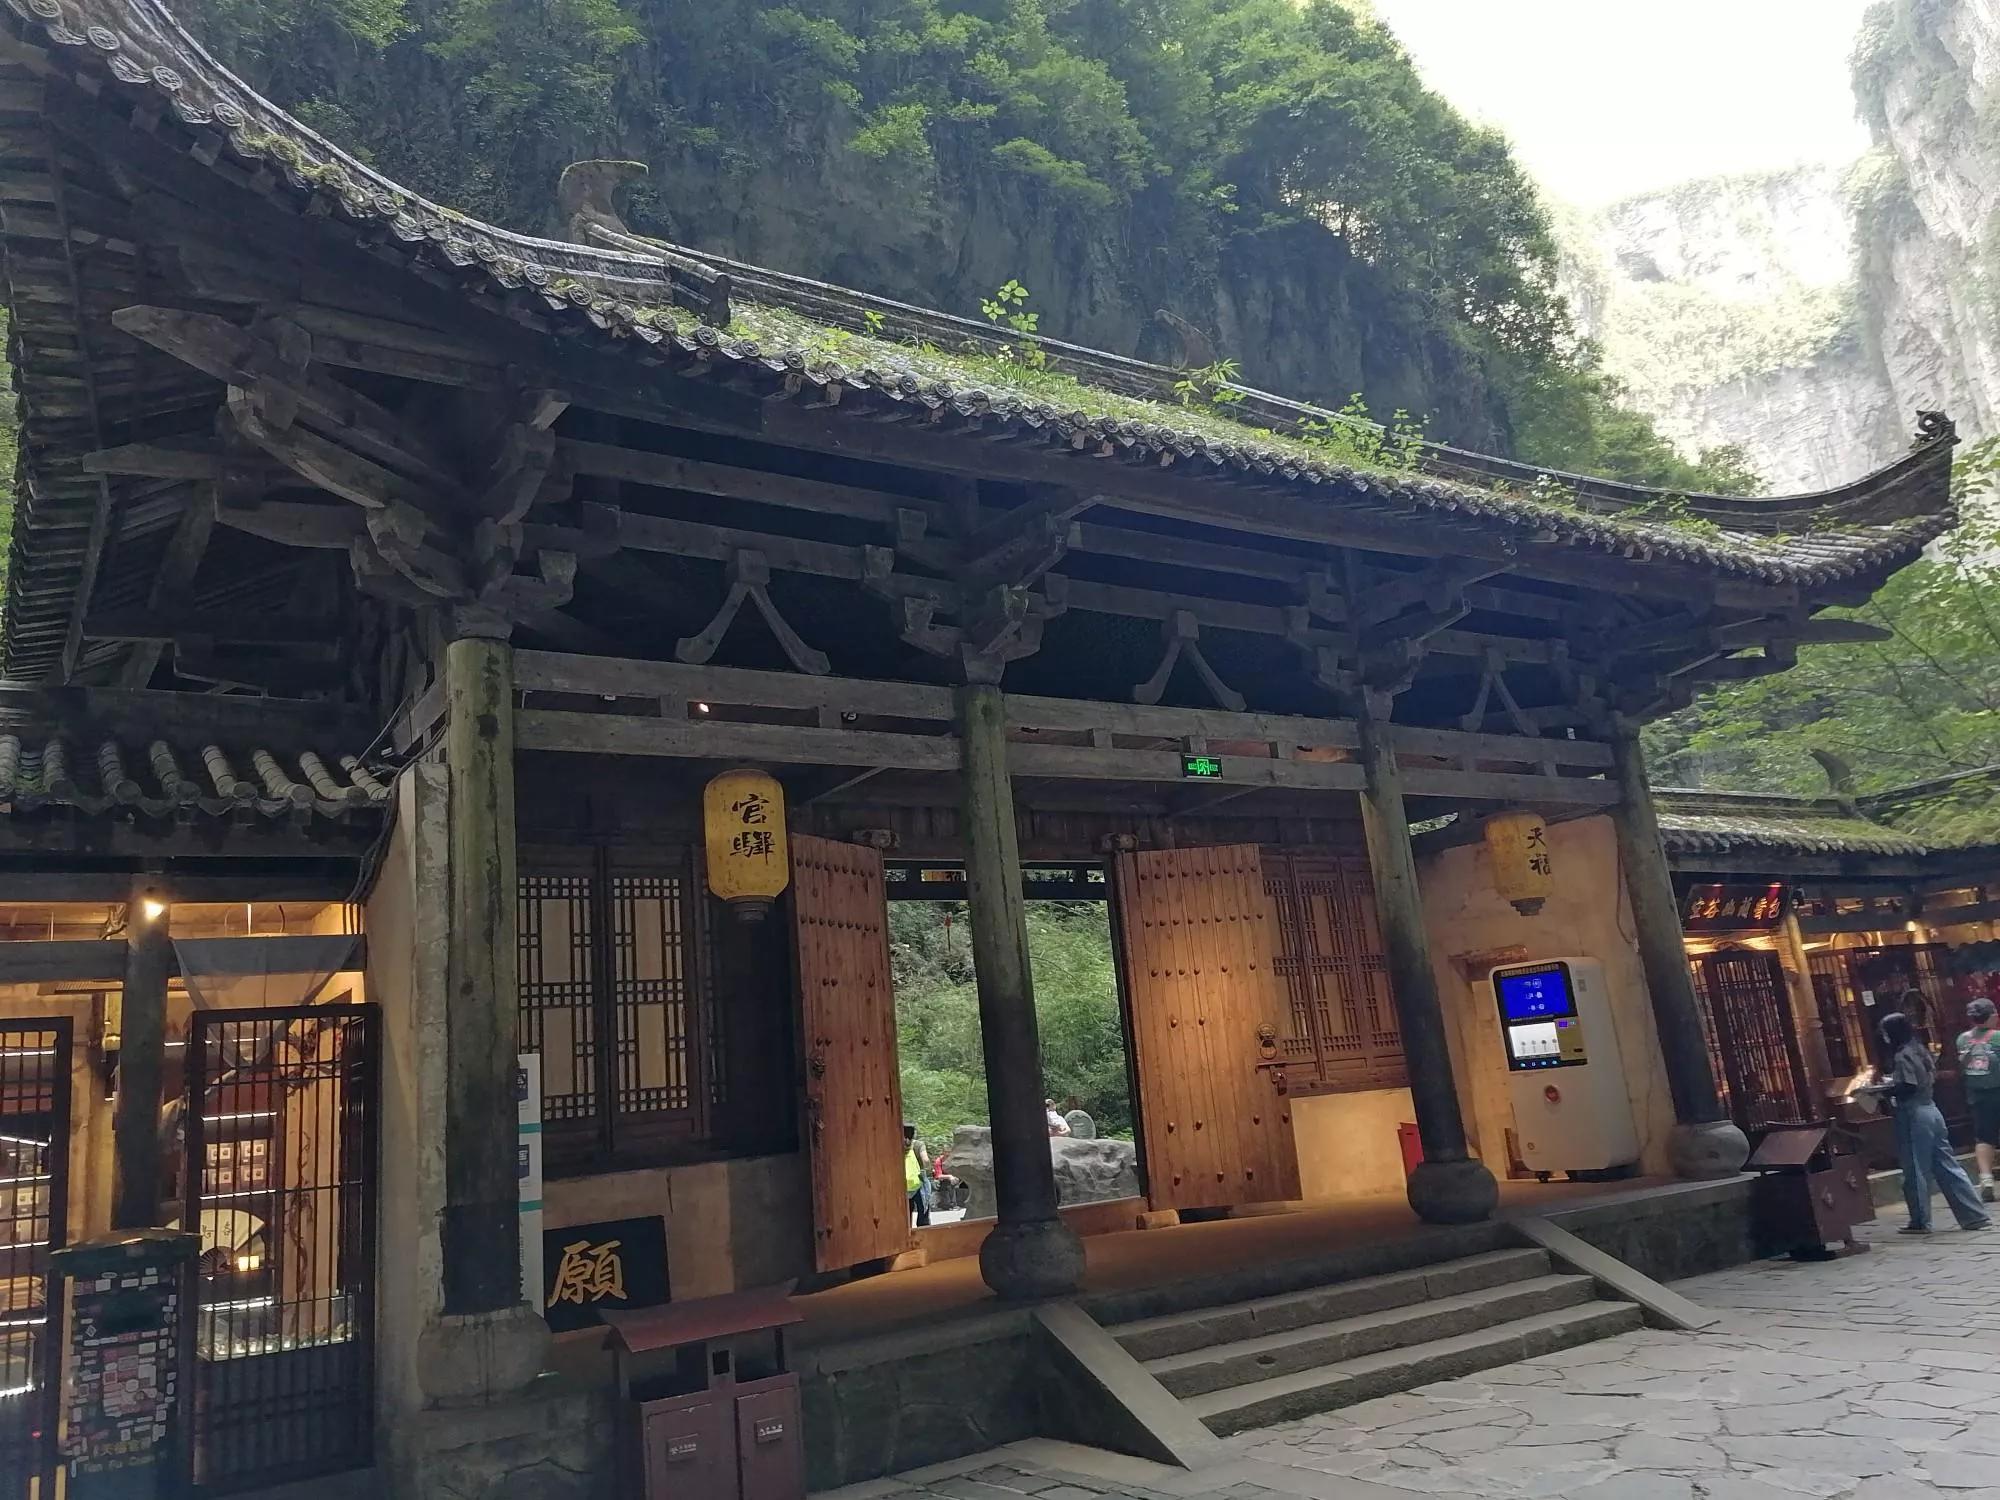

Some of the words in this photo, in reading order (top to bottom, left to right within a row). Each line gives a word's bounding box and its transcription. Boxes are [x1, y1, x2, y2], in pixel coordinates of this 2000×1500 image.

[730, 794, 776, 866] 官驛
[1527, 826, 1553, 877] 天福
[546, 1240, 629, 1308] 願
